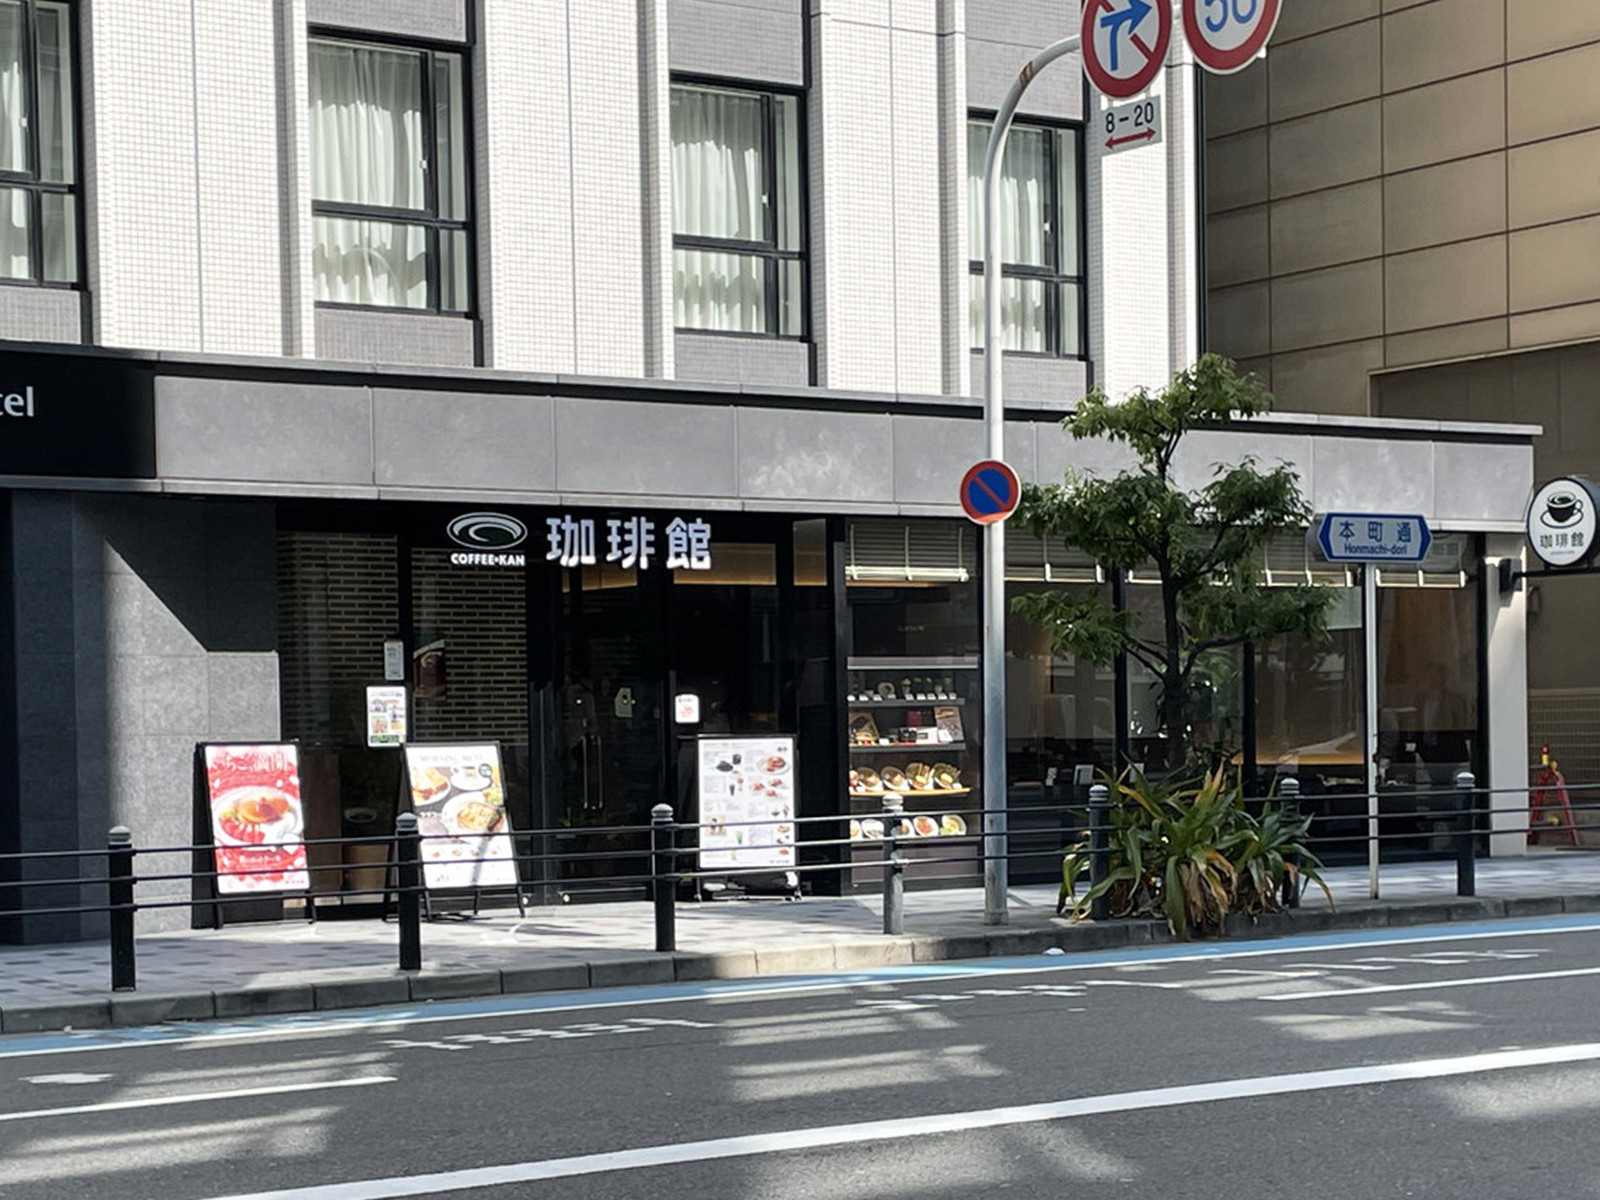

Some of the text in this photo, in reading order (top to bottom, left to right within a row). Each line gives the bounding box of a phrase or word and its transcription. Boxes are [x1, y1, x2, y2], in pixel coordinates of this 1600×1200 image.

[545, 514, 712, 570] 珈琲館
[1338, 521, 1412, 543] 本町通
[1344, 543, 1408, 556] Honmachi-dori
